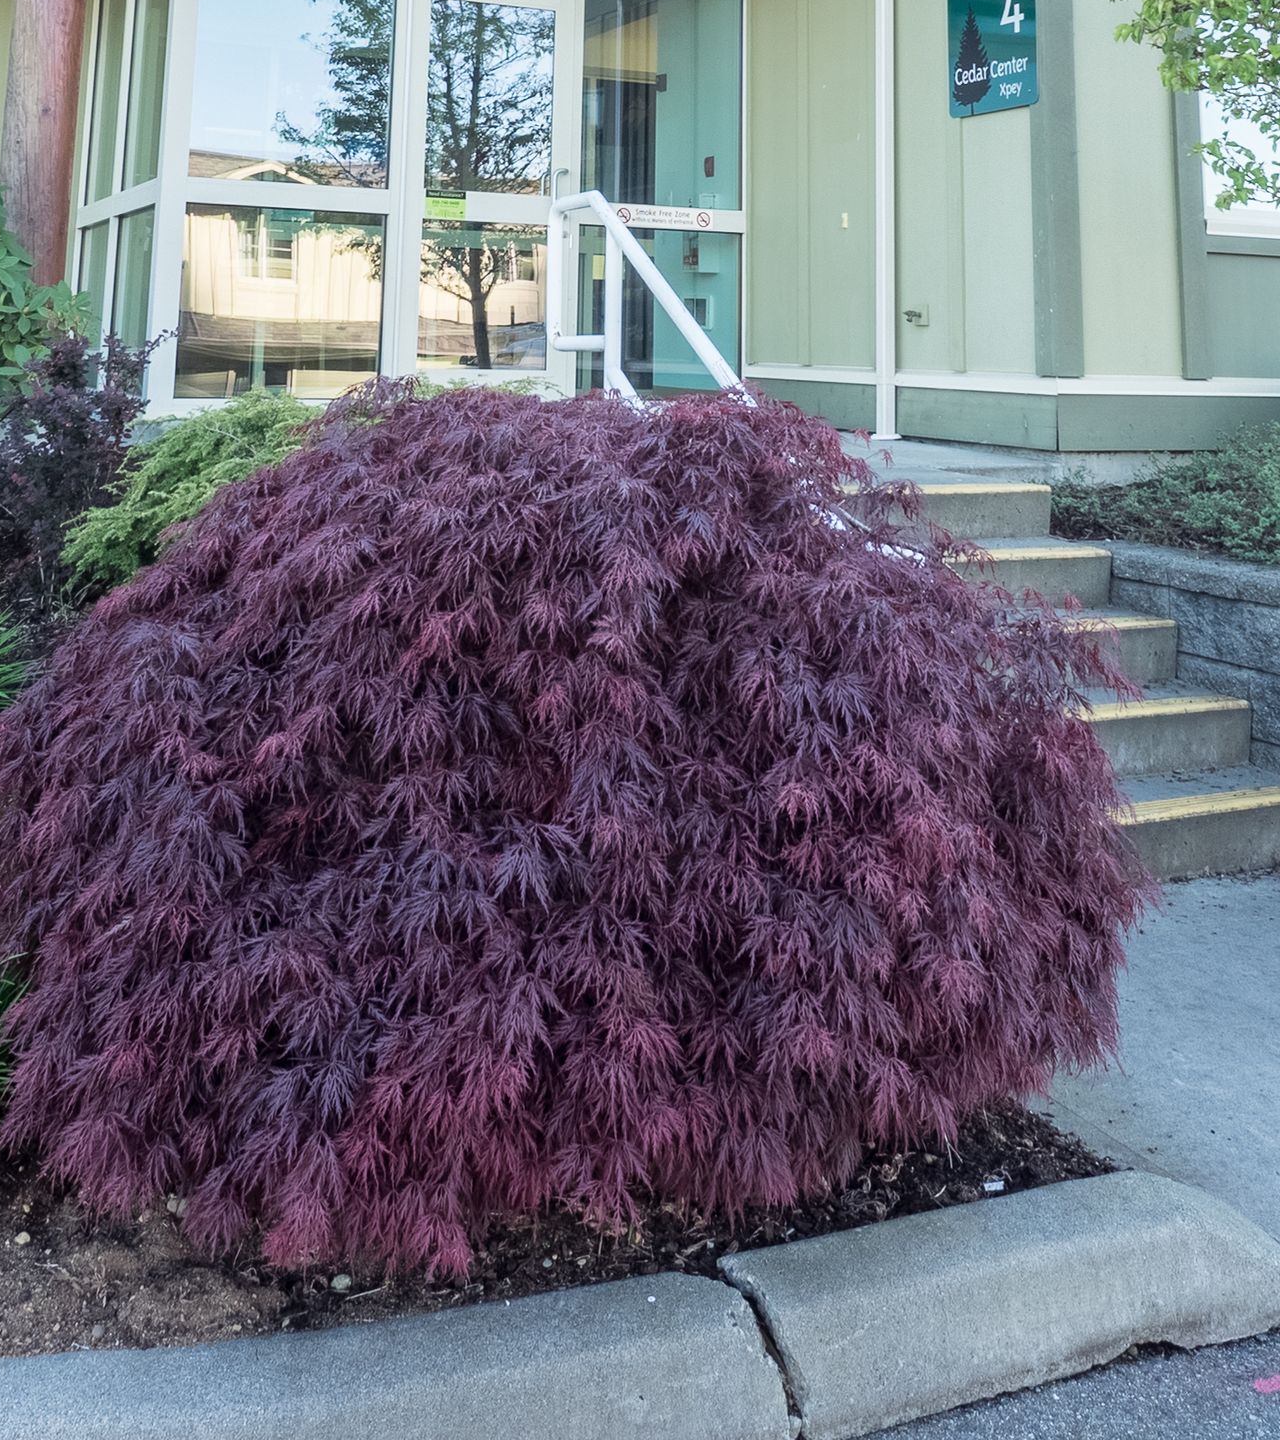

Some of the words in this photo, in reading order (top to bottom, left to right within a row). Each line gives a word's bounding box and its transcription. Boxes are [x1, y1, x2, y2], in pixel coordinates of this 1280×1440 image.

[955, 63, 989, 86] Cedar
[989, 56, 1028, 79] Center
[999, 81, 1022, 99] Xpey
[635, 208, 656, 217] Smoke
[659, 210, 672, 218] Free
[674, 211, 691, 219] Zone
